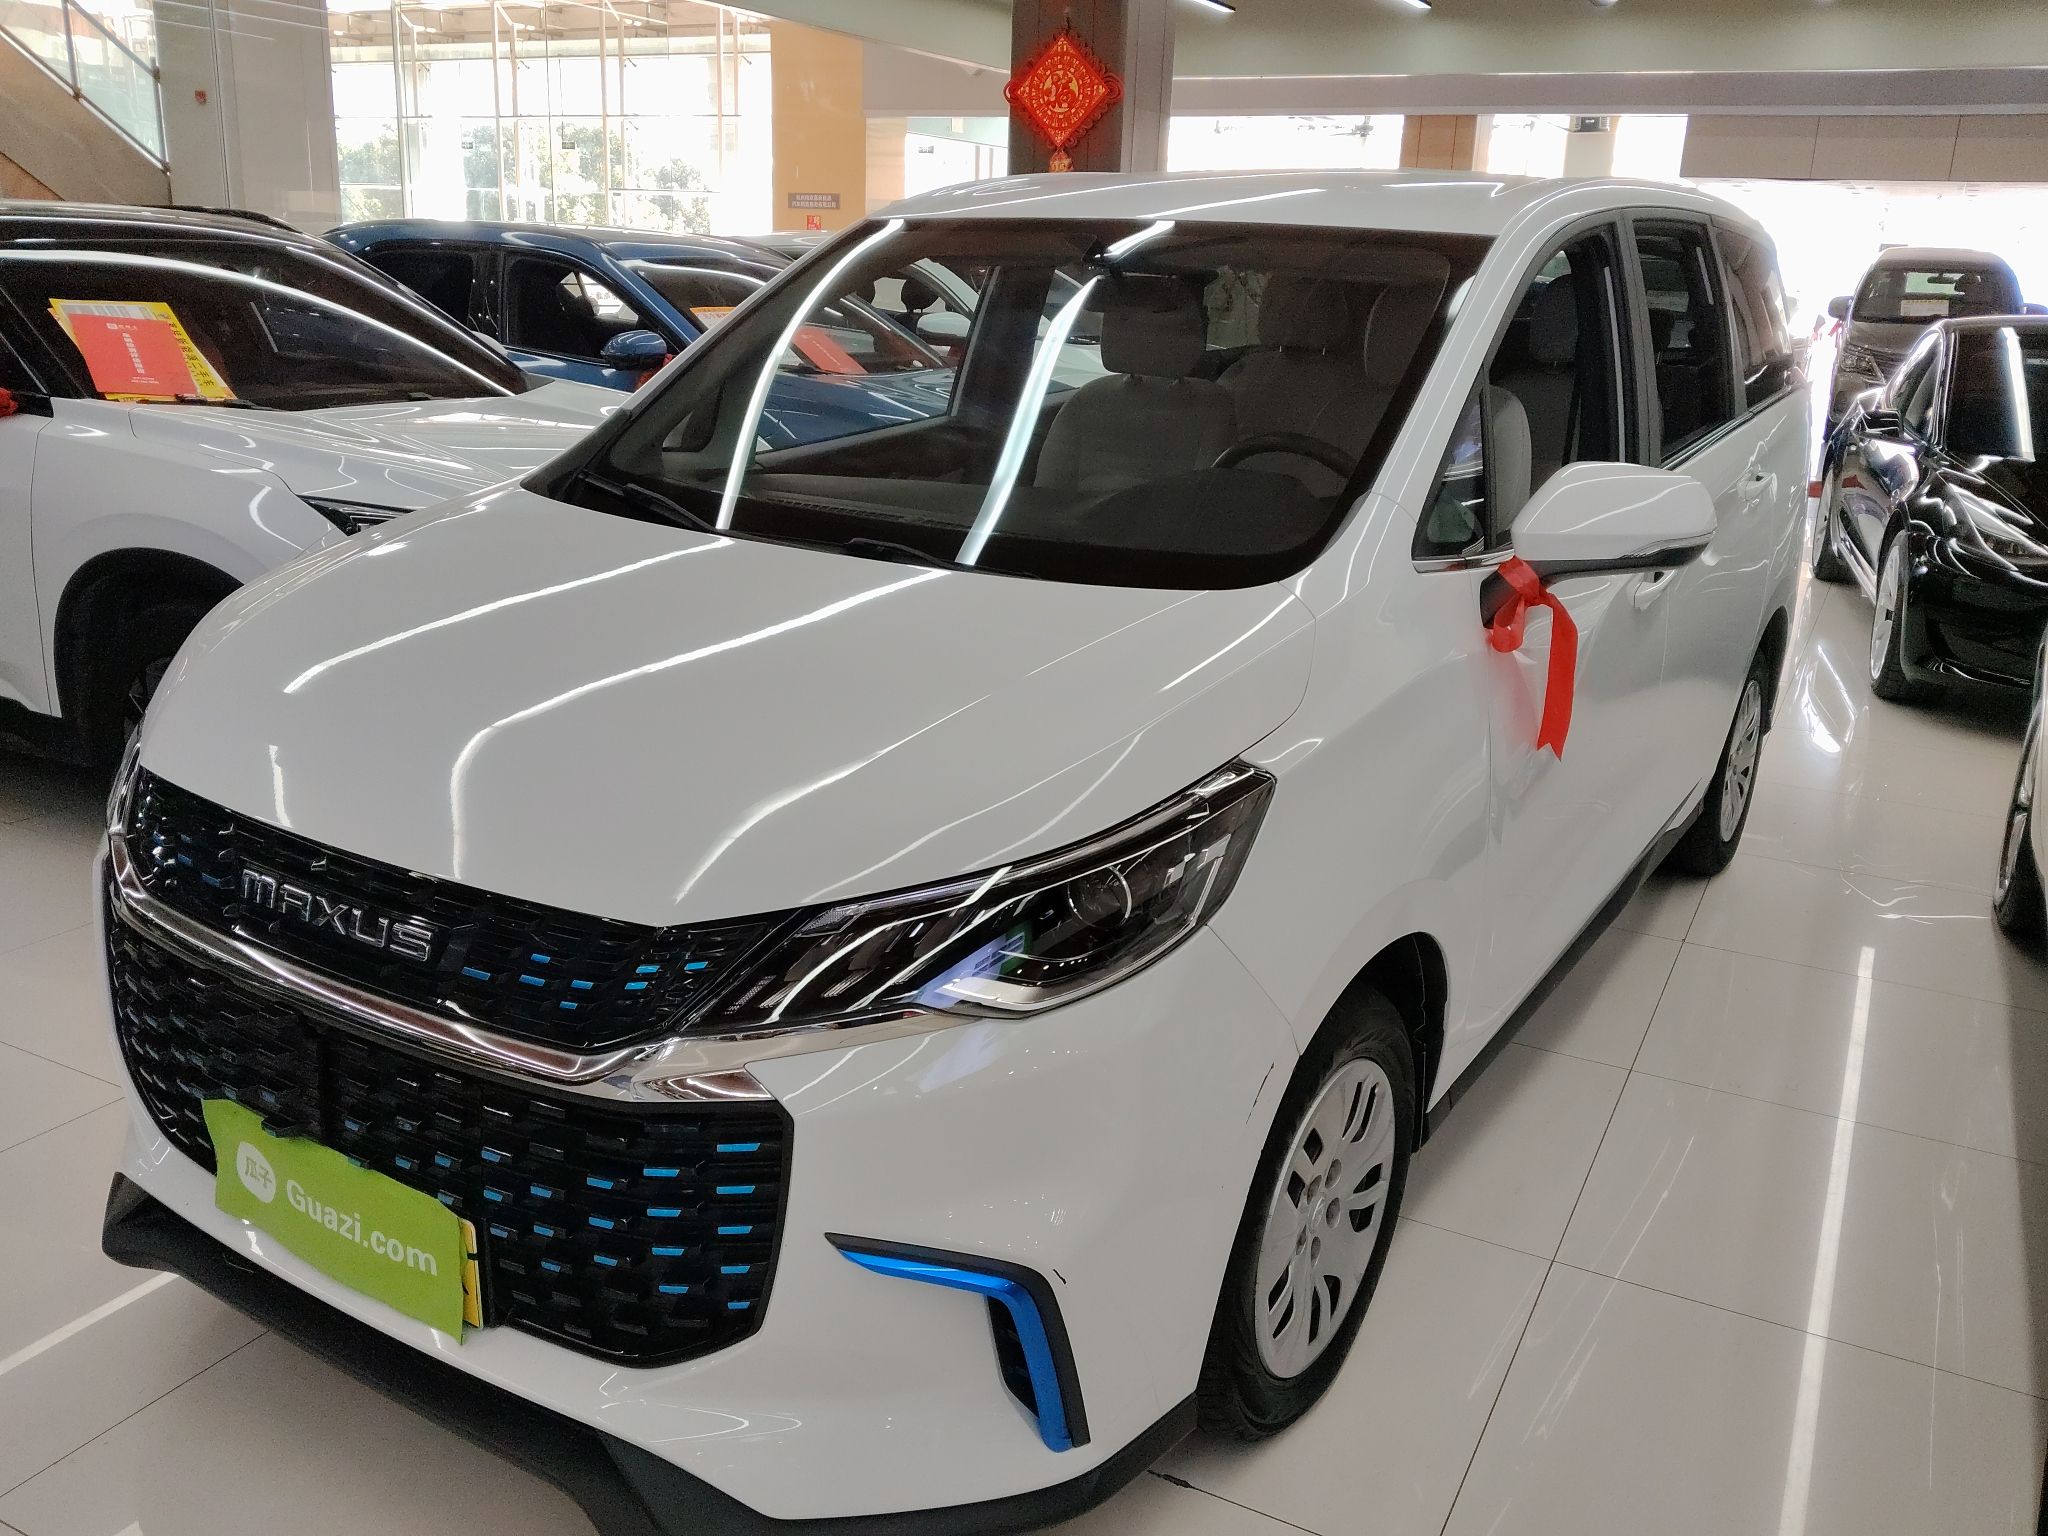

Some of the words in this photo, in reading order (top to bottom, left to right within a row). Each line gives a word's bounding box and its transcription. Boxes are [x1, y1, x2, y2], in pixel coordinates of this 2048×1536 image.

[242, 868, 433, 962] MAXUS
[245, 1156, 272, 1189] 瓜子
[286, 1179, 438, 1277] Guazi.com
